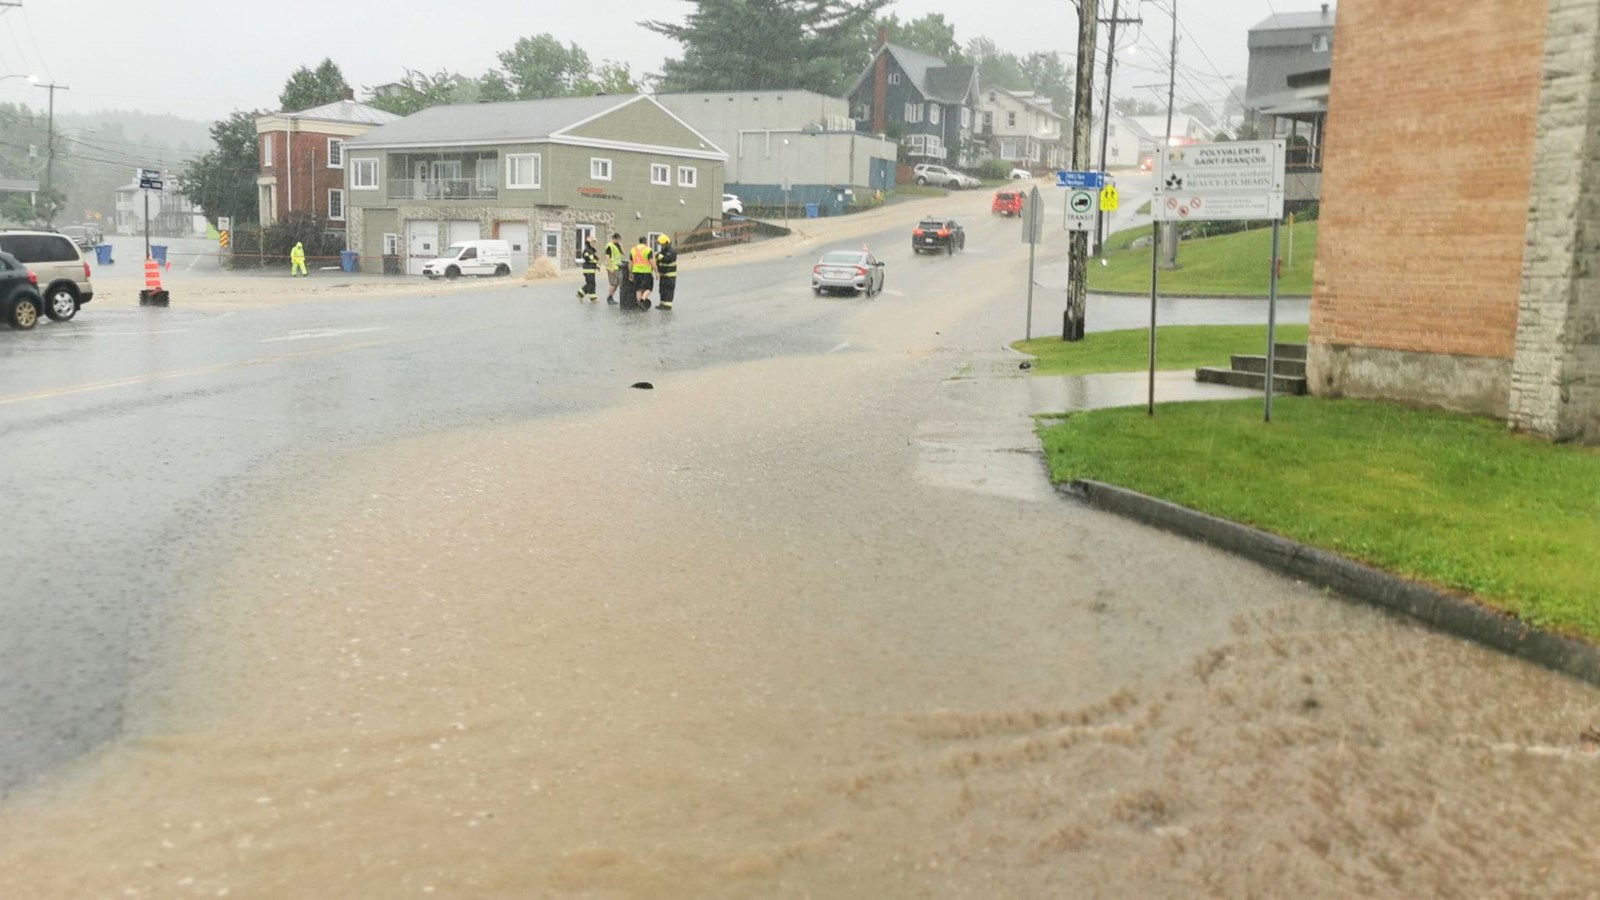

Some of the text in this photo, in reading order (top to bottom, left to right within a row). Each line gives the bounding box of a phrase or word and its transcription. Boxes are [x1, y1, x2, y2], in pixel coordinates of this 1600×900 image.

[1199, 147, 1260, 157] POLYVALENTE
[1194, 156, 1267, 165] SAINT-FRANÇOIS
[1240, 170, 1272, 178] scolaire
